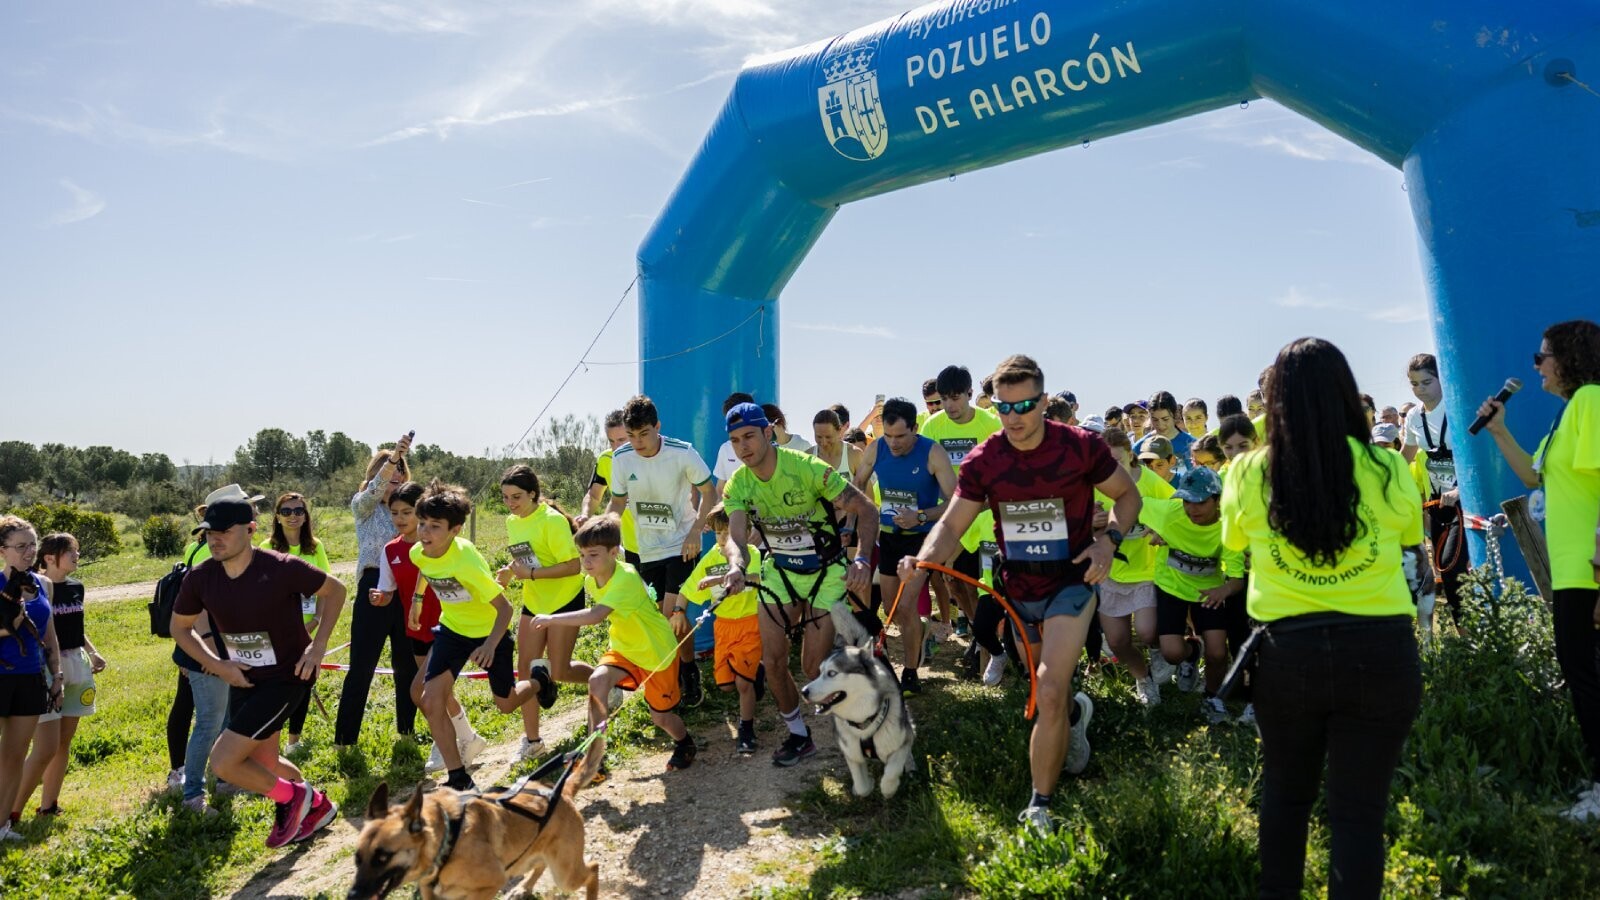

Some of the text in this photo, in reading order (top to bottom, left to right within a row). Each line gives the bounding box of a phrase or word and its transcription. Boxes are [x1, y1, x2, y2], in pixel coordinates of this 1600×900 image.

[906, 12, 1051, 87] POZUELO
[915, 33, 1142, 135] DE ALARCÓN
[950, 451, 969, 460] 19
[1006, 502, 1056, 511] DACIA
[646, 515, 668, 524] 174
[1016, 521, 1053, 533] 250
[1026, 544, 1048, 554] 441
[787, 557, 804, 565] 440
[235, 650, 263, 659] 006
